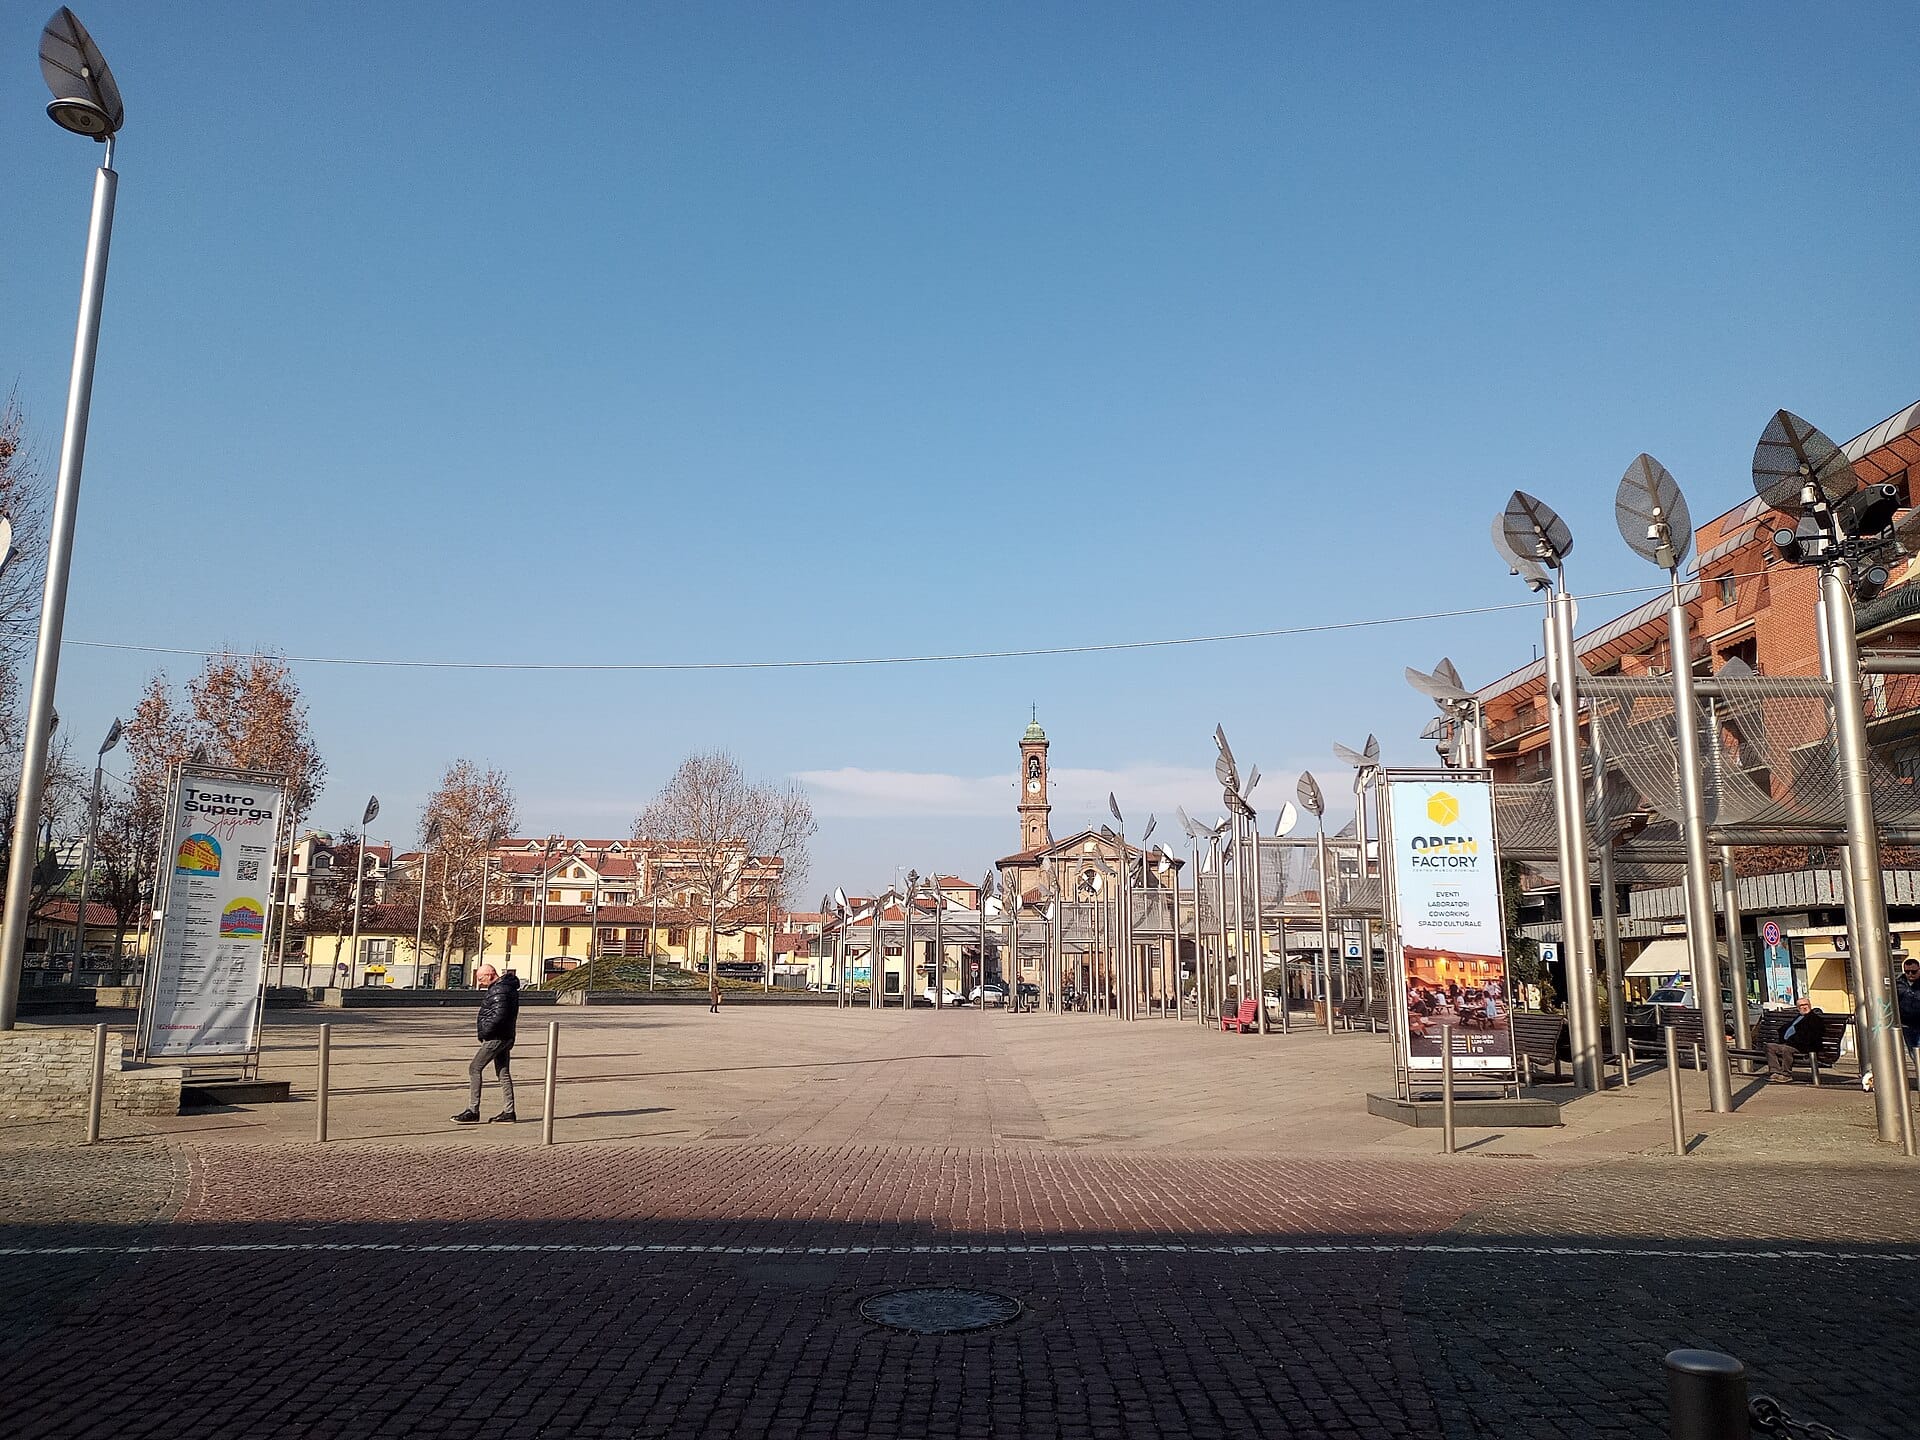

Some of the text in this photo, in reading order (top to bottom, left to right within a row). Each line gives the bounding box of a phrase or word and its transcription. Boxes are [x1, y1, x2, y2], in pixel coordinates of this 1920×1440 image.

[186, 788, 254, 806] Teatro
[184, 800, 273, 820] Superga
[1411, 836, 1478, 854] OPEN
[1412, 856, 1478, 868] FACTORY
